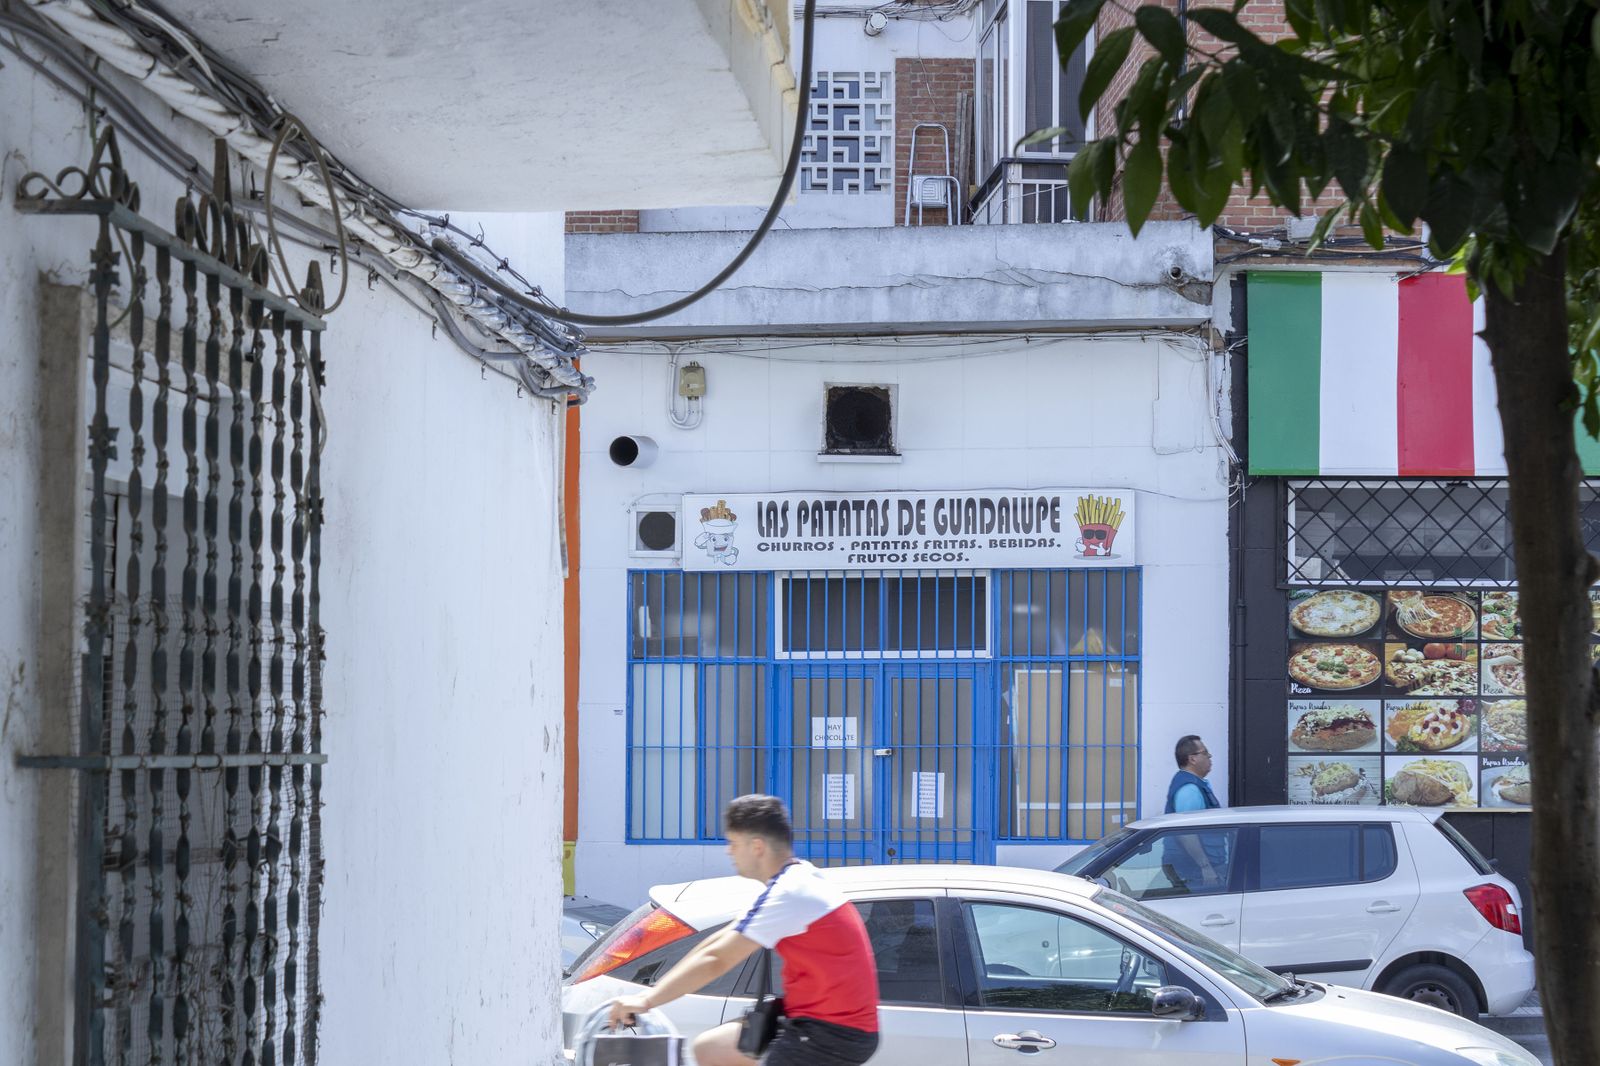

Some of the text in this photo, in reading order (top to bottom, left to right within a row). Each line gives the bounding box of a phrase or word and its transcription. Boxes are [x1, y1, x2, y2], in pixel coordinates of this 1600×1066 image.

[757, 496, 1061, 538] LAS PATATAS DE GUADALUPE
[757, 541, 834, 552] CHURROS
[850, 540, 918, 551] PATATAS
[924, 539, 983, 550] FRITAS.
[988, 537, 1062, 549] BEBIDAS.
[847, 552, 970, 563] FRUTOS SECOS.
[1290, 682, 1312, 694] Pizza
[1482, 683, 1504, 694] Pizza
